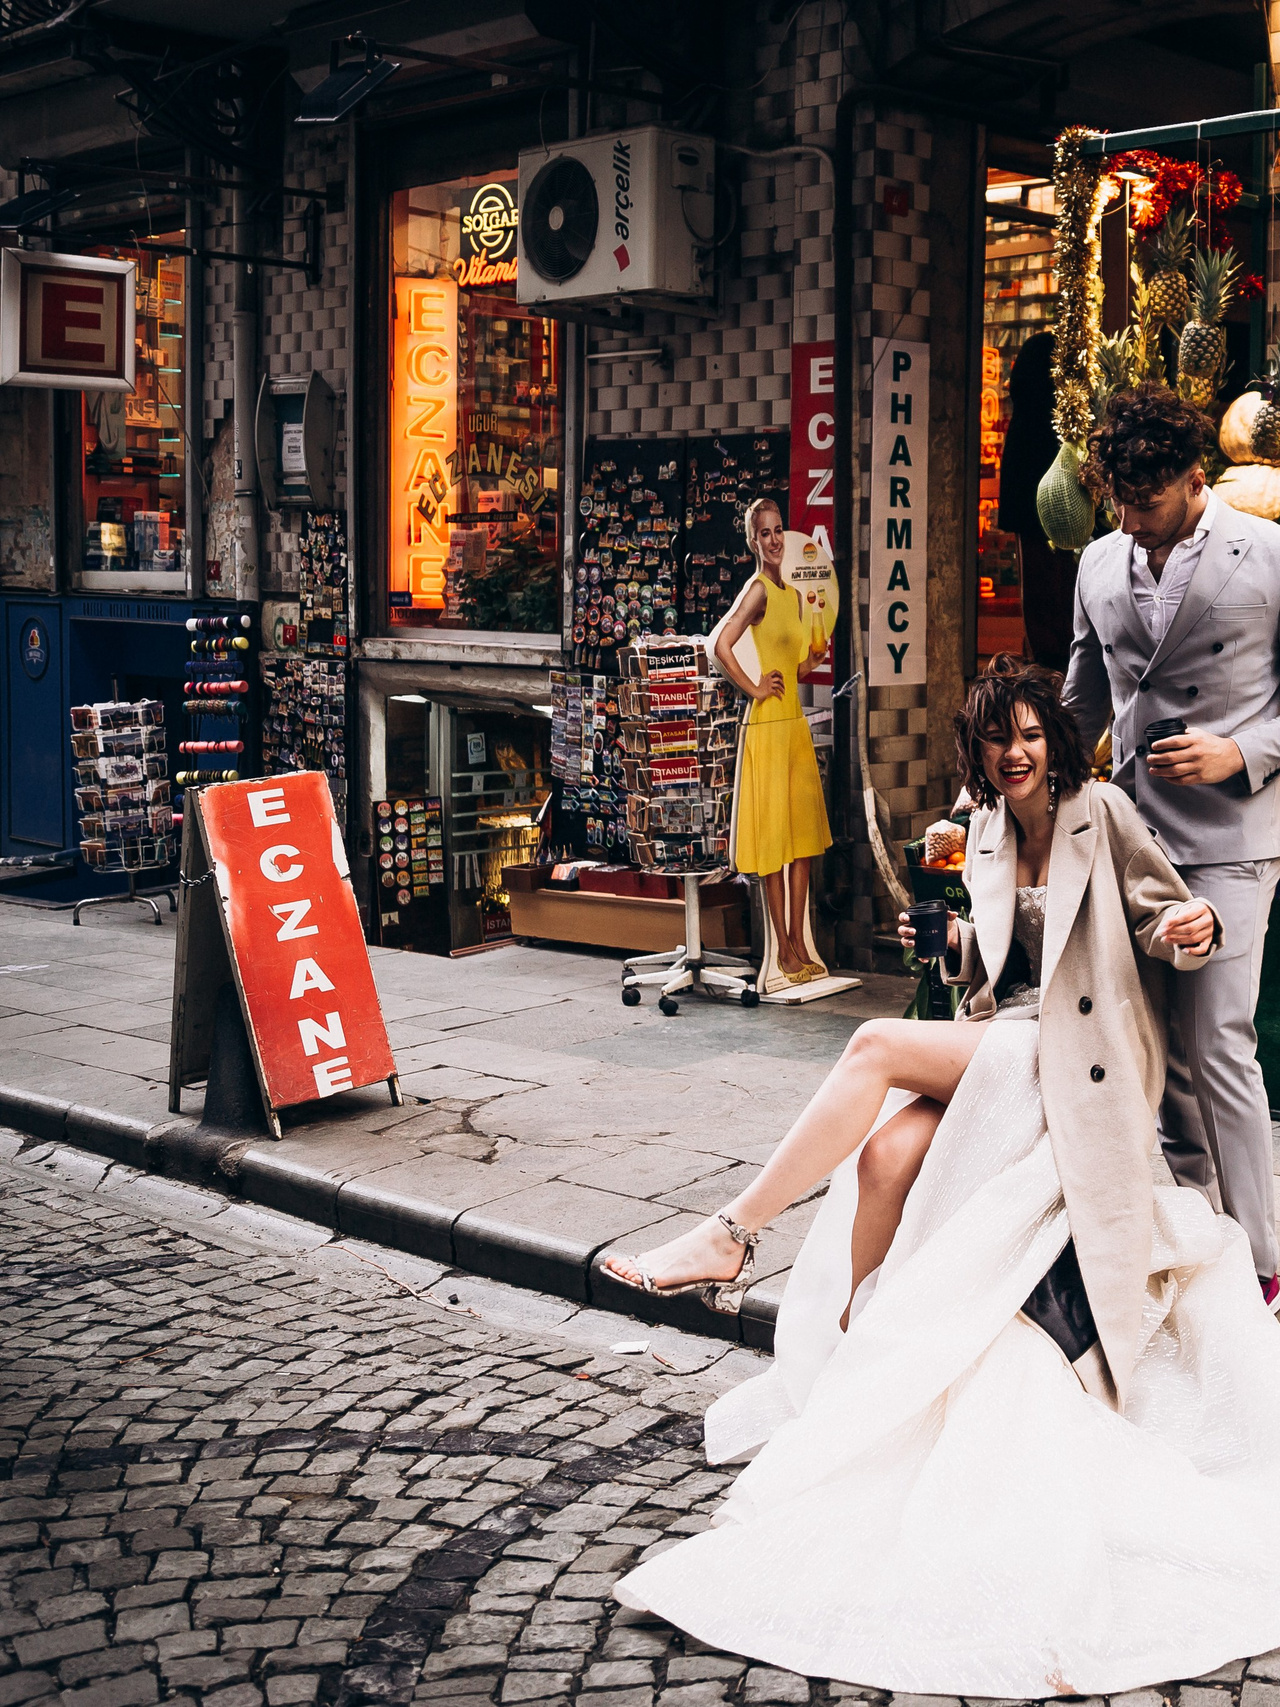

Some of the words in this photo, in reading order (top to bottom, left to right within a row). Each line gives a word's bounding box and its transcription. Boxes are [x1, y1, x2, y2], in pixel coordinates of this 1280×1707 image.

[41, 281, 105, 363] E
[453, 247, 519, 287] Vitami
[612, 139, 633, 241] arçelik
[404, 289, 452, 599] ECZANE
[806, 356, 834, 673] ECZA
[886, 350, 913, 674] PHARMACY
[246, 787, 353, 1098] ECZANE
